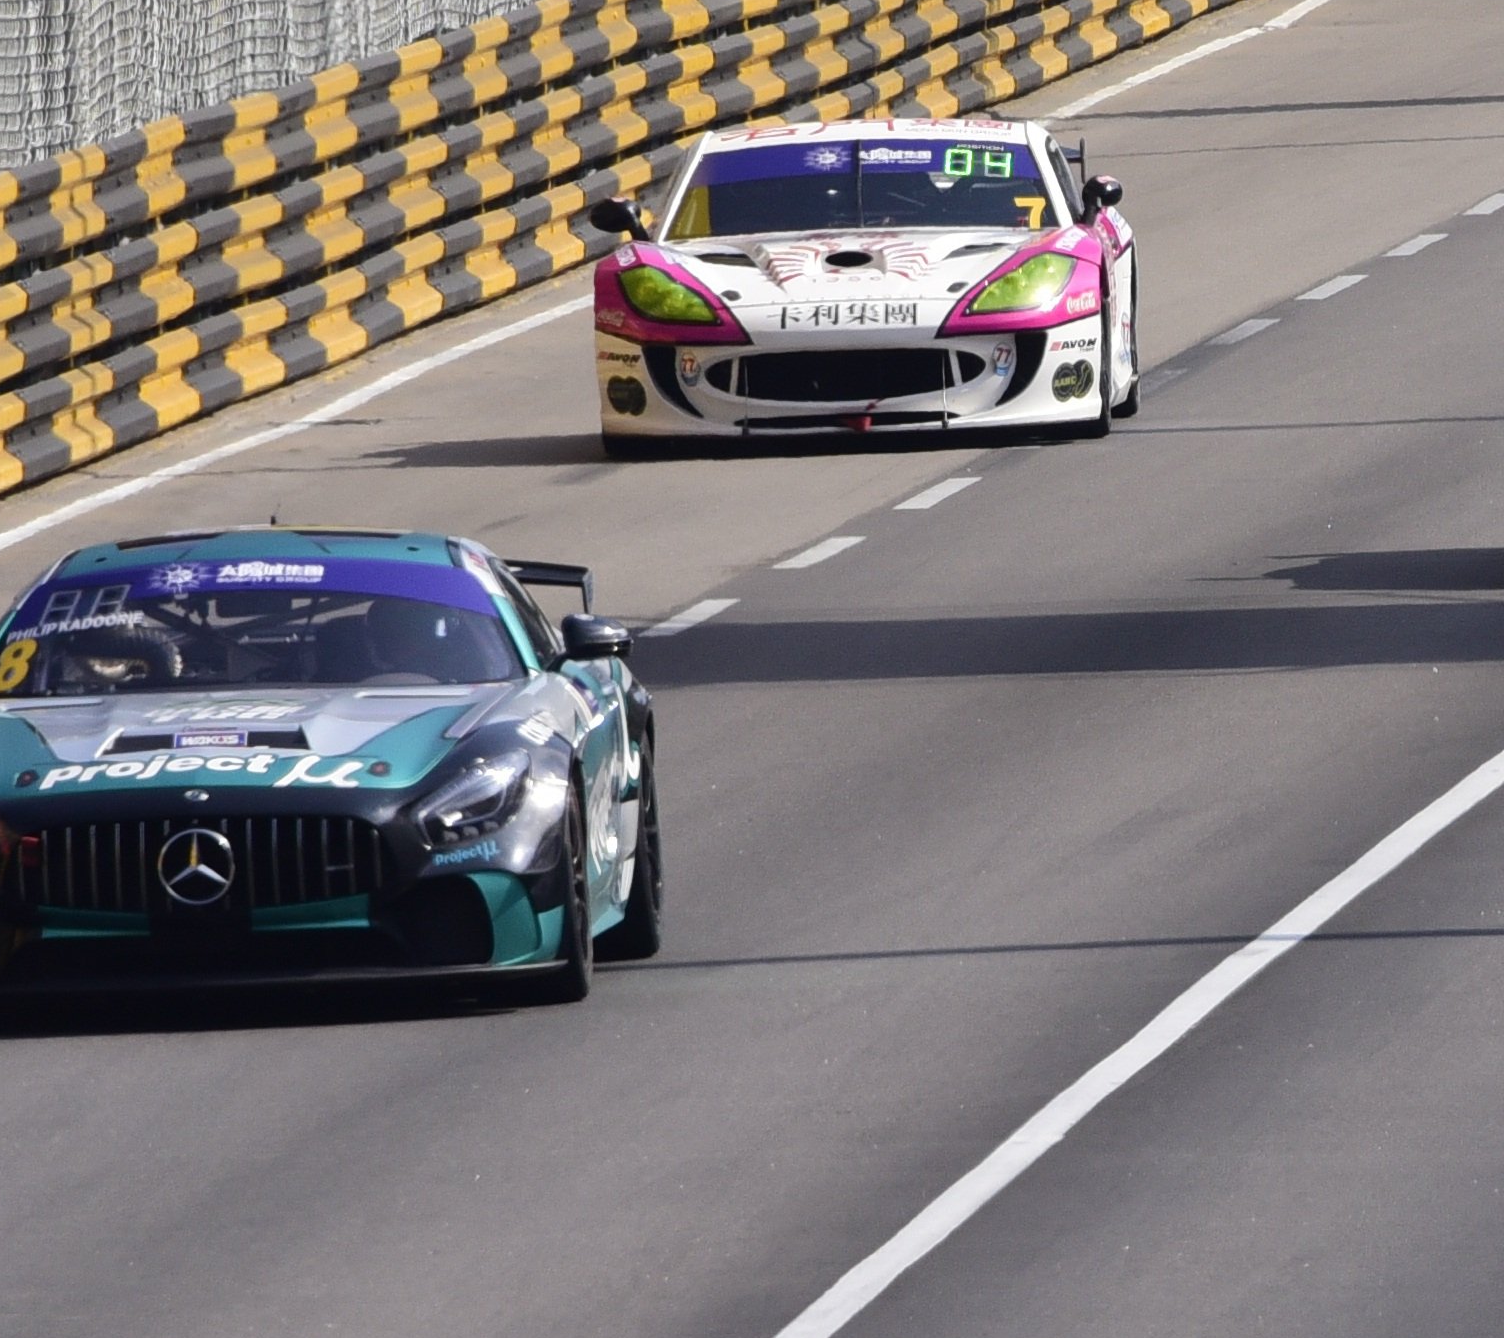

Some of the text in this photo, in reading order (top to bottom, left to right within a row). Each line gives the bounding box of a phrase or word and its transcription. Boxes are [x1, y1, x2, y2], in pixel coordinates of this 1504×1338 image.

[945, 148, 1012, 178] 04
[1014, 197, 1047, 229] 7
[767, 302, 919, 329] 卡利集團
[1060, 338, 1097, 350] AVON
[6, 611, 146, 644] PHILIP KADOORIE
[39, 753, 280, 790] project
